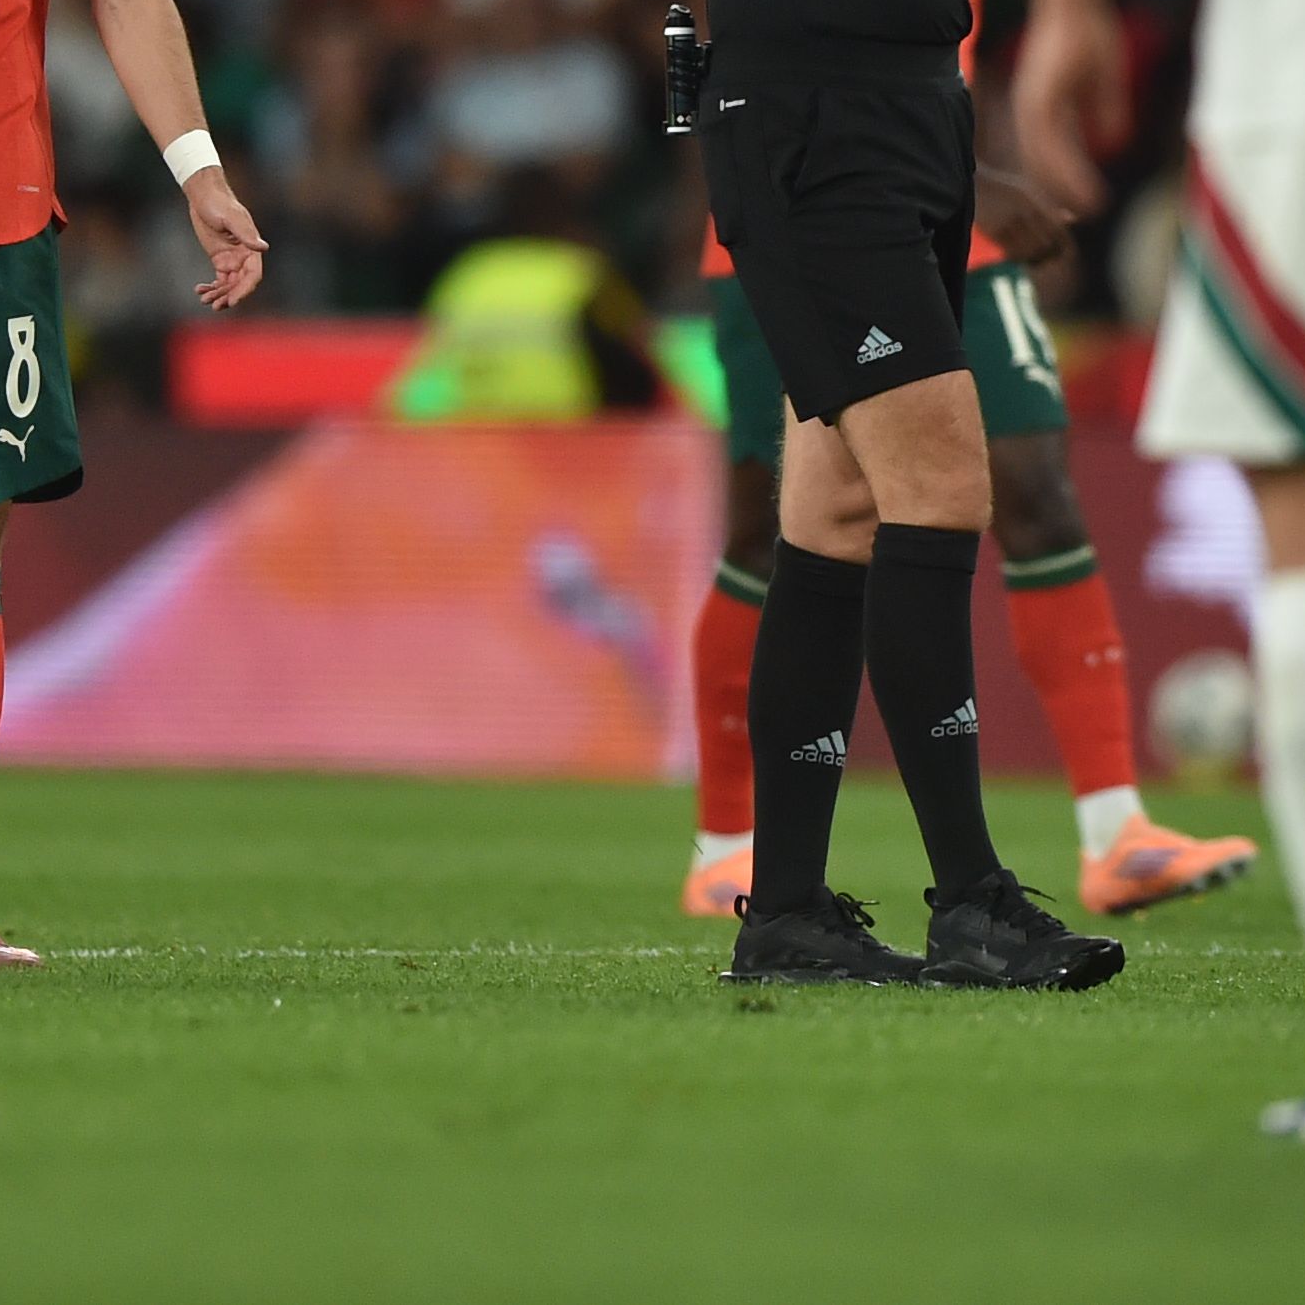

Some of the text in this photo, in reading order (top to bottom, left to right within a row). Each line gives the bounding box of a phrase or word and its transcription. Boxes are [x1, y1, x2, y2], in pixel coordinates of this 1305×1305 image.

[857, 341, 903, 364] adidas
[6, 315, 40, 418] 8
[931, 721, 979, 738] adida
[790, 748, 846, 767] adida
